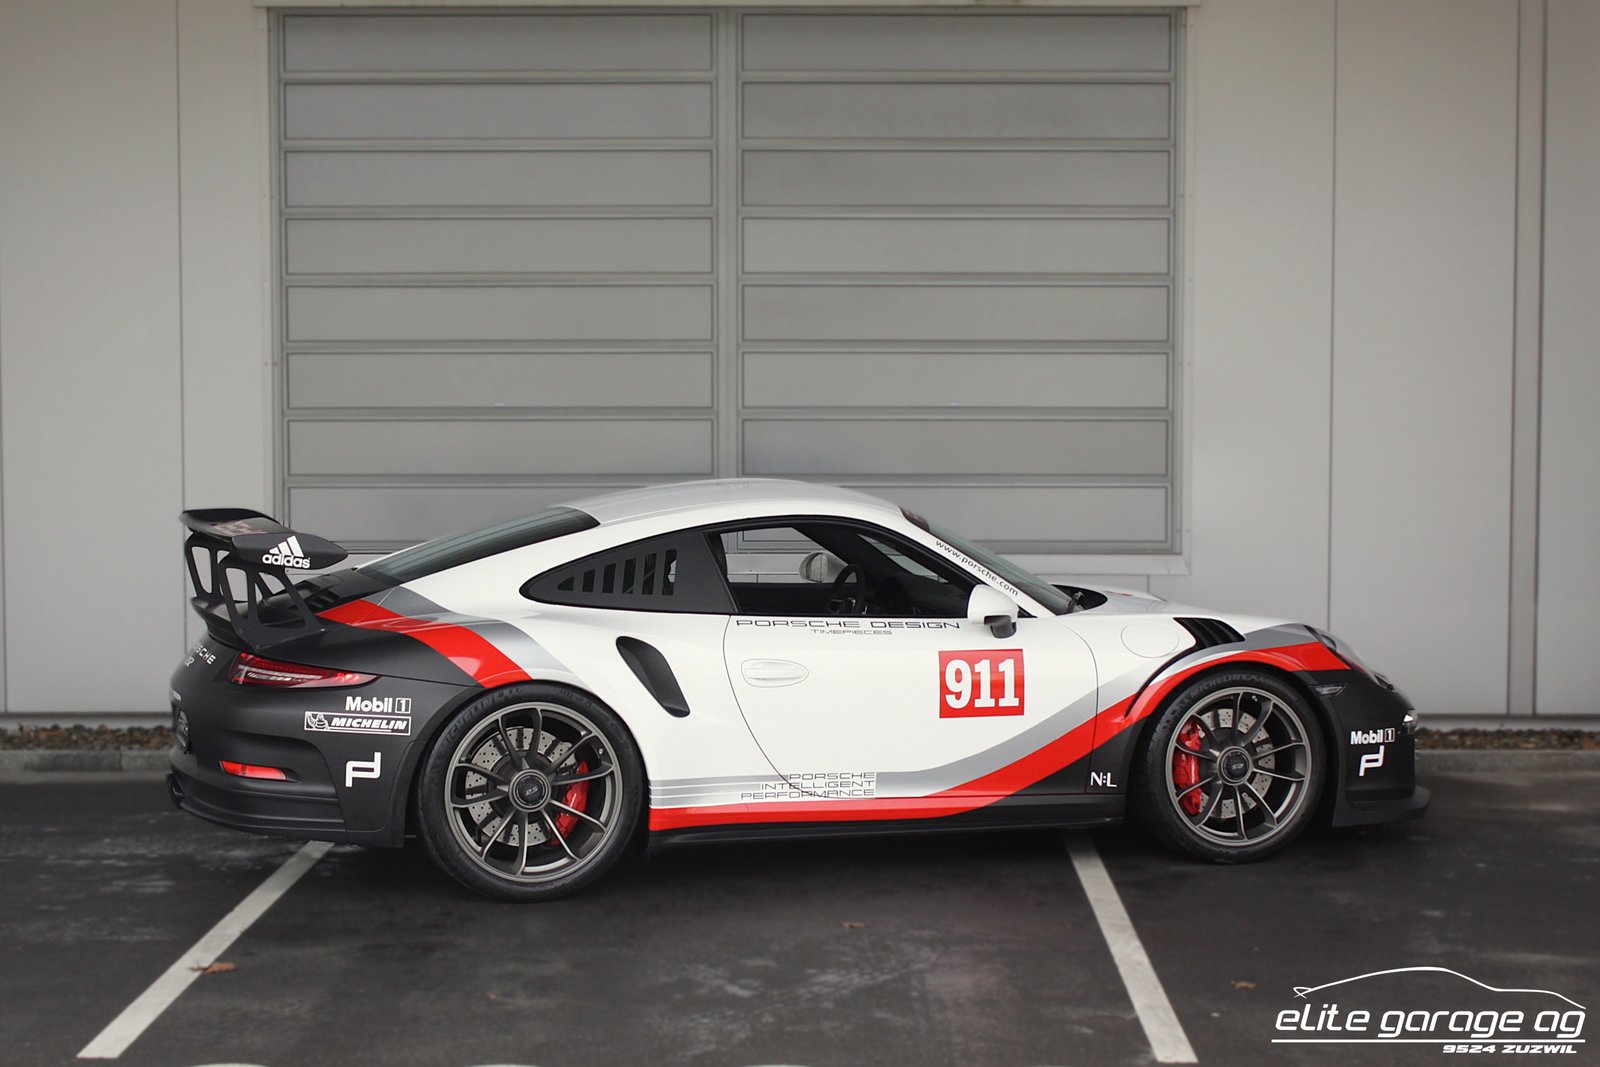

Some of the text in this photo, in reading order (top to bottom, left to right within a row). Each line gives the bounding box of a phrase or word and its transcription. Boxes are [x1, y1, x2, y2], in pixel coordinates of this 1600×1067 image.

[262, 553, 310, 569] adidas
[936, 540, 1018, 597] www.porsche.com
[736, 619, 961, 630] PORSCHE DESIGN
[945, 658, 1019, 709] 911
[345, 696, 393, 713] Mobil
[331, 717, 408, 730] MICHELIN
[1350, 729, 1384, 745] Mobil
[789, 771, 876, 781] PORSCHE
[760, 780, 875, 791] INTELLIGENT
[741, 789, 875, 800] PERFORMANCE
